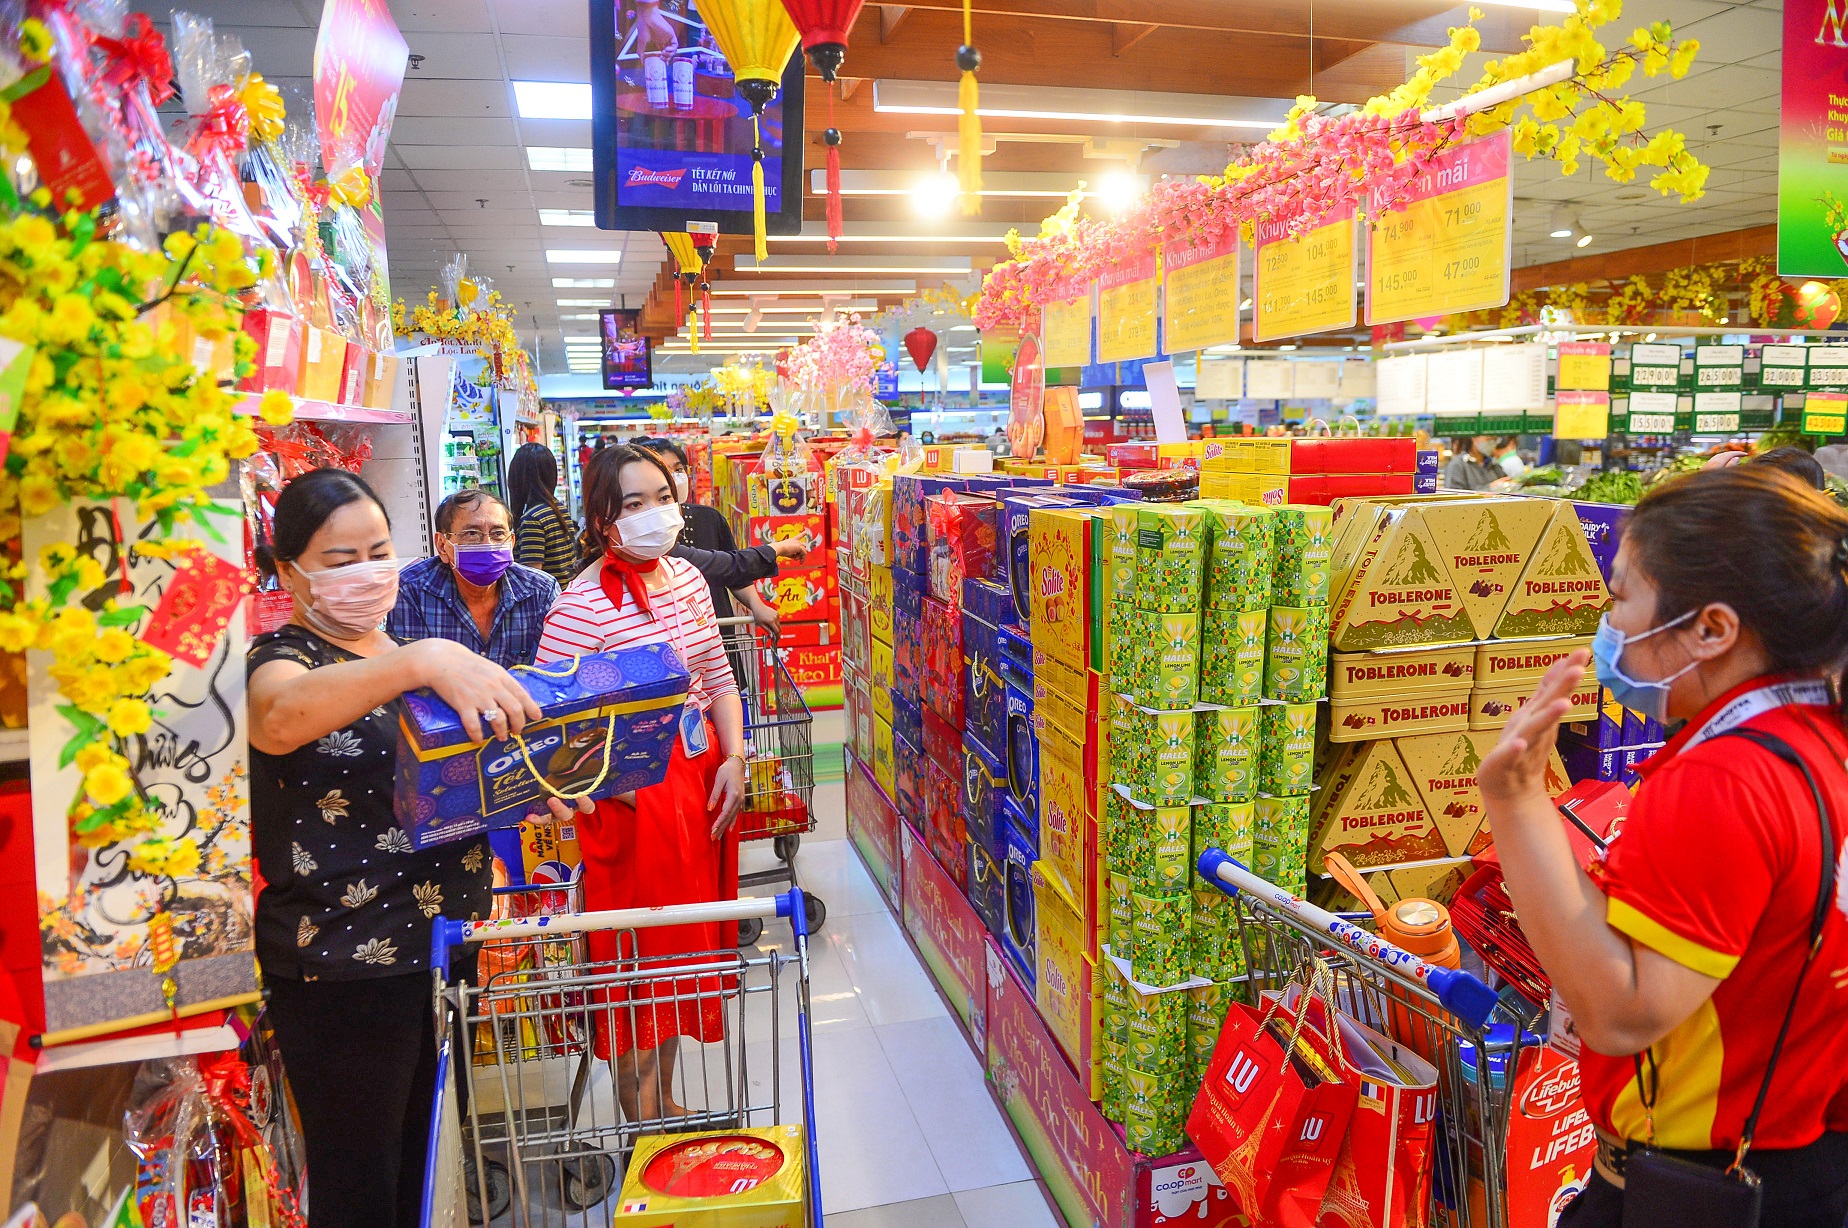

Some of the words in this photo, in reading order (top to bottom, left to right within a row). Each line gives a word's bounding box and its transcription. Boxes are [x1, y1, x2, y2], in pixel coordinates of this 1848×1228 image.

[1828, 110, 1848, 124] Khuy
[1827, 128, 1844, 142] Giá
[629, 170, 681, 182] Budweiser
[692, 167, 704, 179] TẾT
[706, 168, 721, 180] KẾT
[722, 168, 736, 180] NỐI
[1437, 158, 1468, 188] mãi
[709, 181, 721, 193] LỐI
[723, 185, 732, 194] TA
[1444, 257, 1480, 280] 47.000
[1379, 270, 1417, 293] 145.000
[652, 382, 666, 392] hịt
[927, 453, 937, 463] LU
[1205, 442, 1222, 460] Solite
[856, 471, 867, 484] LU
[1011, 514, 1029, 531] OREO
[1113, 546, 1134, 555] HALLS
[1169, 541, 1195, 549] HALLS
[1218, 540, 1245, 549] HALLS
[1304, 550, 1329, 558] HALLS
[1454, 553, 1520, 569] TOBLERONE
[1041, 566, 1064, 597] Solite
[1525, 579, 1601, 598] TOBLERONE
[780, 588, 800, 603] An
[1369, 589, 1452, 609] TOBLERONE
[1237, 650, 1262, 659] HALLS
[1272, 646, 1302, 654] HALLS
[1164, 654, 1192, 662] HALLS
[1346, 662, 1438, 684] TOBLERONE
[1008, 696, 1026, 713] OREO
[1381, 702, 1468, 725] TOBLERONE
[1286, 742, 1312, 750] HALLS
[487, 736, 560, 774] OREO
[1160, 752, 1188, 760] HALLS
[493, 768, 527, 790] Tết
[1428, 776, 1479, 793] TOBLER
[1048, 800, 1067, 834] Solite
[1341, 810, 1425, 832] TOBLERONE
[1008, 844, 1026, 865] OREO
[1158, 844, 1186, 853] HALLS
[1112, 908, 1132, 918] HALL
[1137, 921, 1160, 931] HALLS
[1045, 956, 1067, 997] Solite
[1131, 1020, 1157, 1032] HALLS
[1189, 1013, 1217, 1024] HALLS
[1225, 1050, 1259, 1093] LU
[1530, 1076, 1580, 1102] Lifebu
[1129, 1103, 1154, 1116] HALLS
[1414, 1092, 1437, 1124] LU
[1300, 1117, 1323, 1141] LU
[1530, 1123, 1597, 1170] LIFEB
